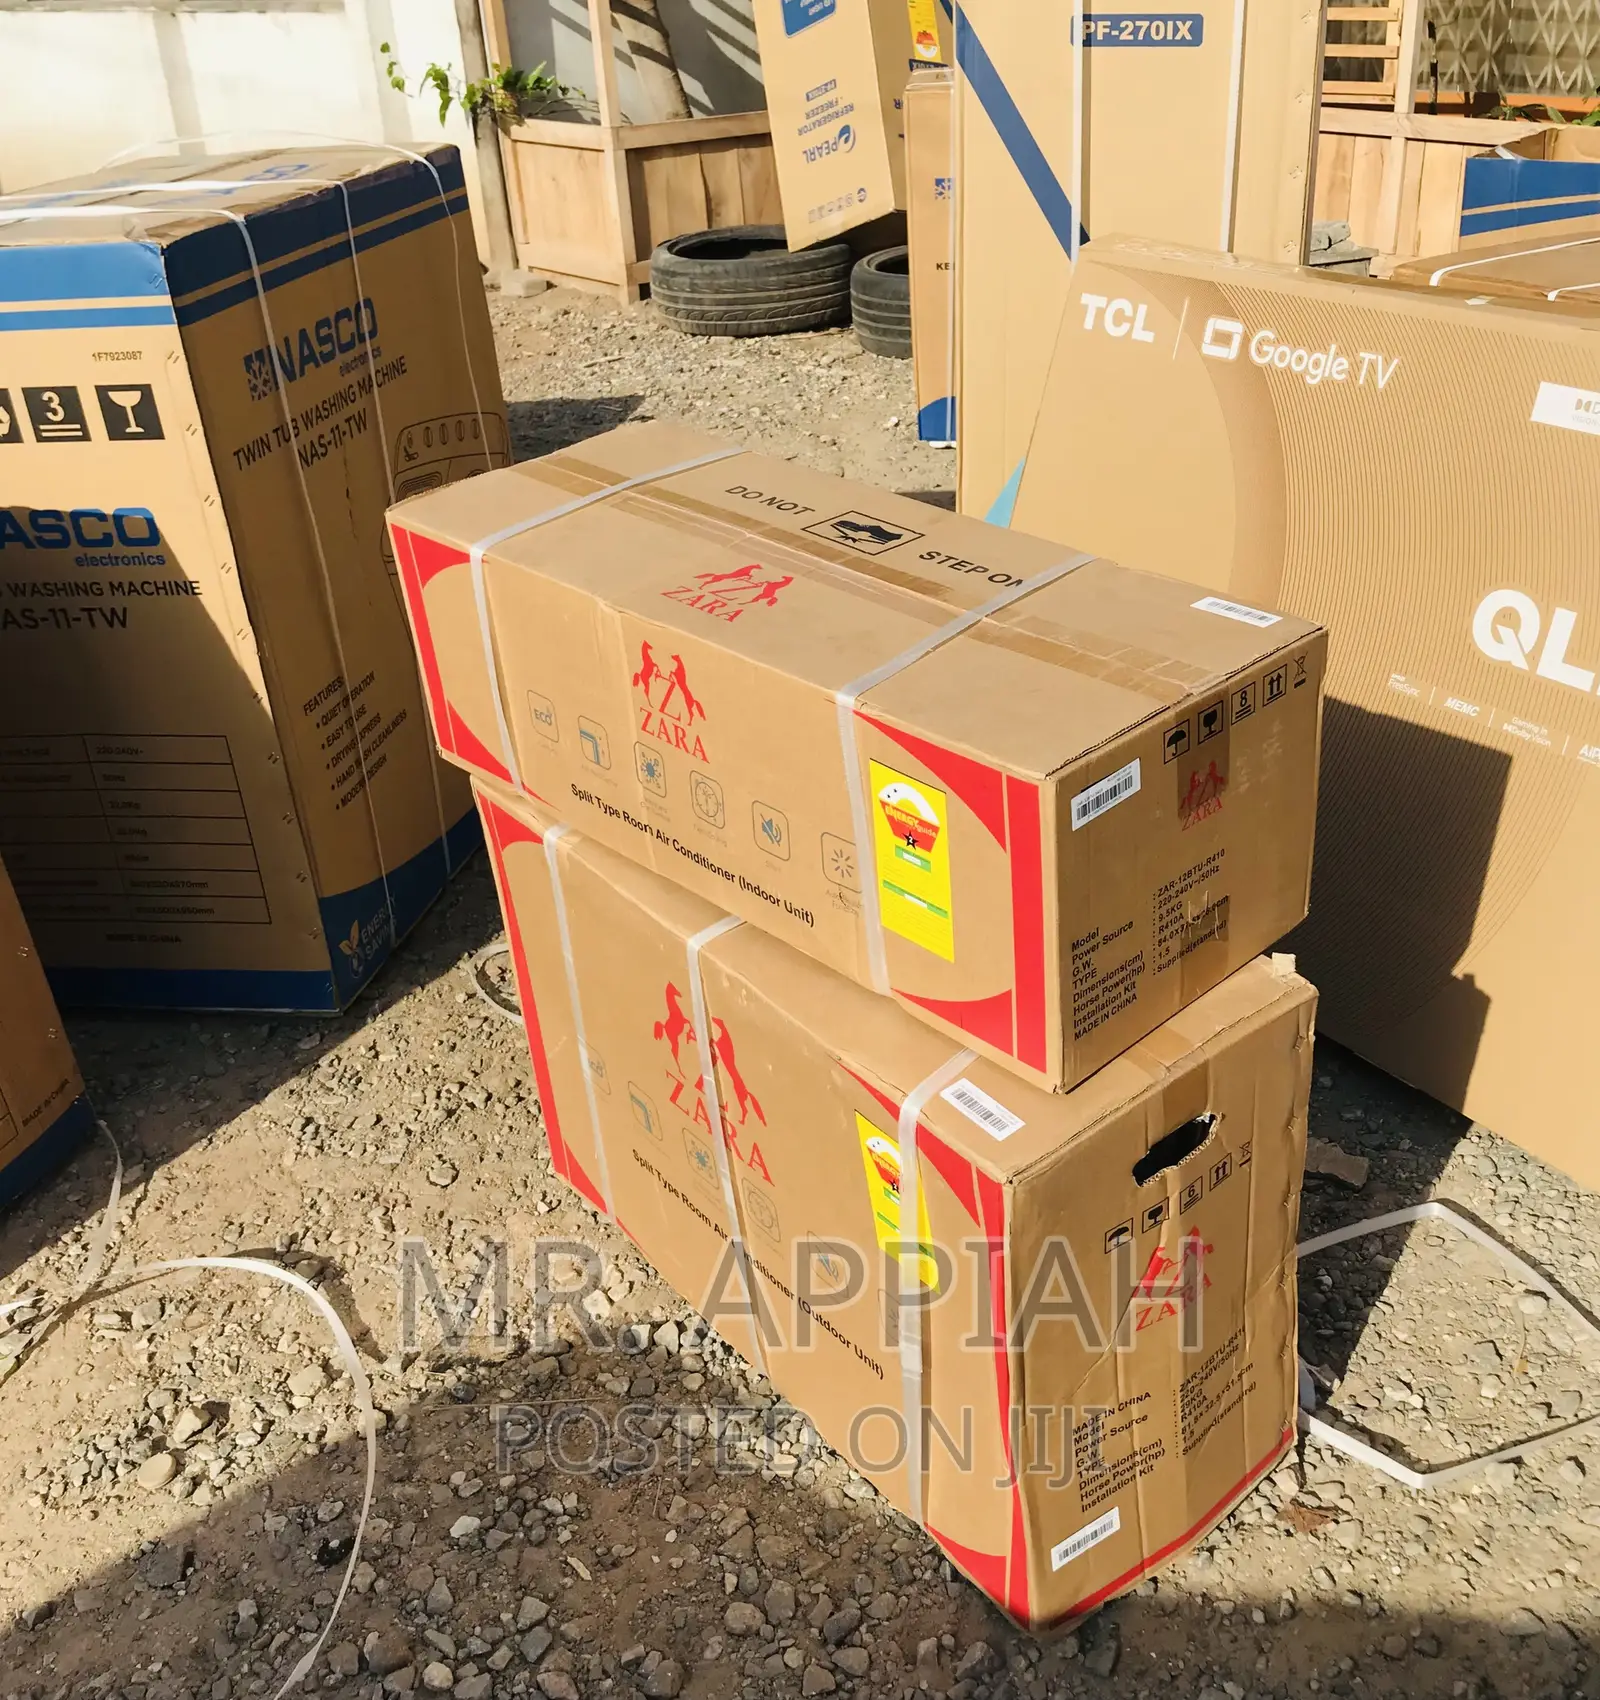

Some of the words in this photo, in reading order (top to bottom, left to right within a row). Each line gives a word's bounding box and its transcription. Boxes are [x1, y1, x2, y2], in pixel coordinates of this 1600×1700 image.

[1080, 19, 1194, 42] PF-270IX
[802, 136, 839, 164] PEARL
[936, 262, 955, 271] KE
[1079, 292, 1156, 343] TCL
[92, 349, 143, 364] 1F7923087
[267, 297, 379, 391] NASCO
[339, 346, 382, 377] electroncs
[1250, 329, 1349, 385] Google
[1357, 352, 1398, 389] TV
[43, 390, 66, 422] 3
[233, 433, 272, 472] TWIN
[272, 417, 300, 448] TUB
[300, 384, 357, 431] WASHING
[357, 355, 408, 400] MACHINE
[297, 407, 369, 472] NAS-11-TW
[724, 484, 764, 500] DO
[760, 494, 816, 517] NOT
[0, 507, 161, 549] ASCO
[75, 552, 166, 567] electronics
[918, 549, 991, 574] STEP
[6, 581, 105, 598] WASHING
[108, 580, 203, 597] MACHINE
[660, 585, 745, 623] ZARA
[1471, 587, 1600, 697] QL
[1239, 689, 1248, 708] 8
[1443, 696, 1480, 718] MEMC
[357, 712, 382, 743] XPRESS
[639, 706, 711, 765] ZARA
[1181, 795, 1224, 833] ZARA
[570, 783, 595, 805] Split
[594, 795, 621, 819] Type
[622, 810, 654, 837] Room
[655, 828, 671, 847] Air
[672, 838, 736, 883] Conditioner
[738, 875, 781, 907] (Indoor
[783, 899, 815, 928] Unit)
[1157, 848, 1226, 898] ZAR-12BTU-R410
[1158, 900, 1184, 923] 9.5KG
[1158, 912, 1185, 936] R410A
[1071, 926, 1101, 953] Model
[1072, 940, 1101, 966] Power
[1102, 920, 1135, 946] Source
[1072, 957, 1095, 979] G.W.
[1072, 967, 1098, 991] TYPE
[1073, 950, 1145, 1004] Dimensions(cm)
[1073, 992, 1101, 1017] Horse
[1102, 962, 1146, 999] Power(hp)
[1073, 988, 1123, 1030] Installation
[1123, 980, 1138, 996] Kit
[1074, 1017, 1101, 1042] MADE
[1100, 1012, 1110, 1025] IN
[1111, 993, 1138, 1016] CHINA
[666, 1069, 776, 1188] ZARA
[1187, 1184, 1196, 1199] 6
[632, 1148, 655, 1176] Split
[655, 1168, 680, 1199] Type
[681, 1192, 712, 1228] Room
[713, 1223, 729, 1242] Air
[797, 1296, 852, 1349] (Outdoor
[854, 1344, 885, 1380] Unit)
[1072, 1413, 1102, 1436] MADE
[1103, 1407, 1116, 1419] IN
[1117, 1391, 1152, 1412] CHINA
[1073, 1421, 1105, 1447] Model
[1075, 1433, 1108, 1458] Power
[1109, 1414, 1149, 1437] Source
[1077, 1456, 1106, 1480] TYPE
[1078, 1438, 1163, 1492] Dimensions(cm)
[1080, 1478, 1111, 1502] Horse
[1112, 1447, 1166, 1481] Power(hp)
[1081, 1474, 1137, 1513] Installation
[1138, 1463, 1155, 1478] Kit
